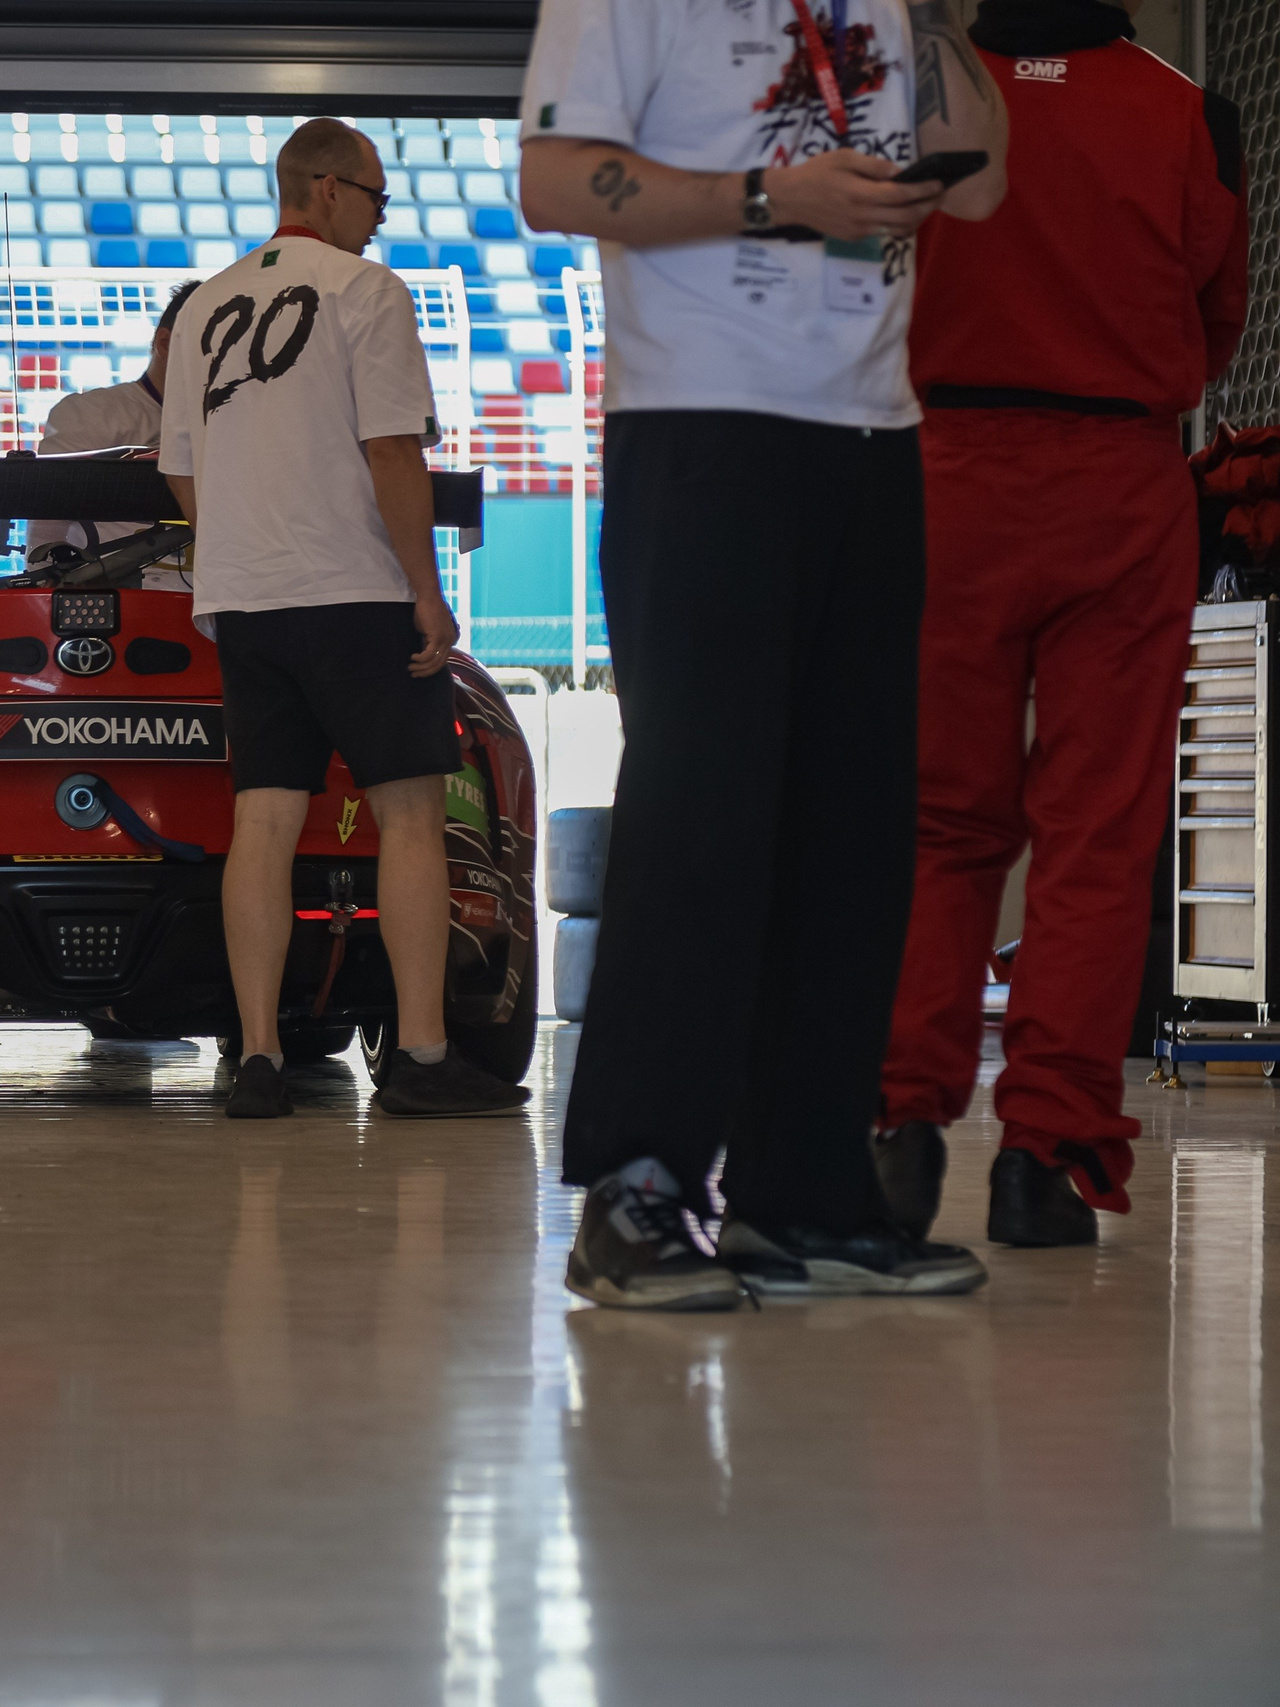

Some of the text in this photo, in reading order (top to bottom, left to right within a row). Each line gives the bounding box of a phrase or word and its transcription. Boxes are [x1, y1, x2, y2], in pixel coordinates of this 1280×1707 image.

[1014, 59, 1068, 79] OMP
[201, 285, 320, 426] 20
[24, 717, 210, 745] YOKOHAMA
[444, 773, 485, 813] TYRES
